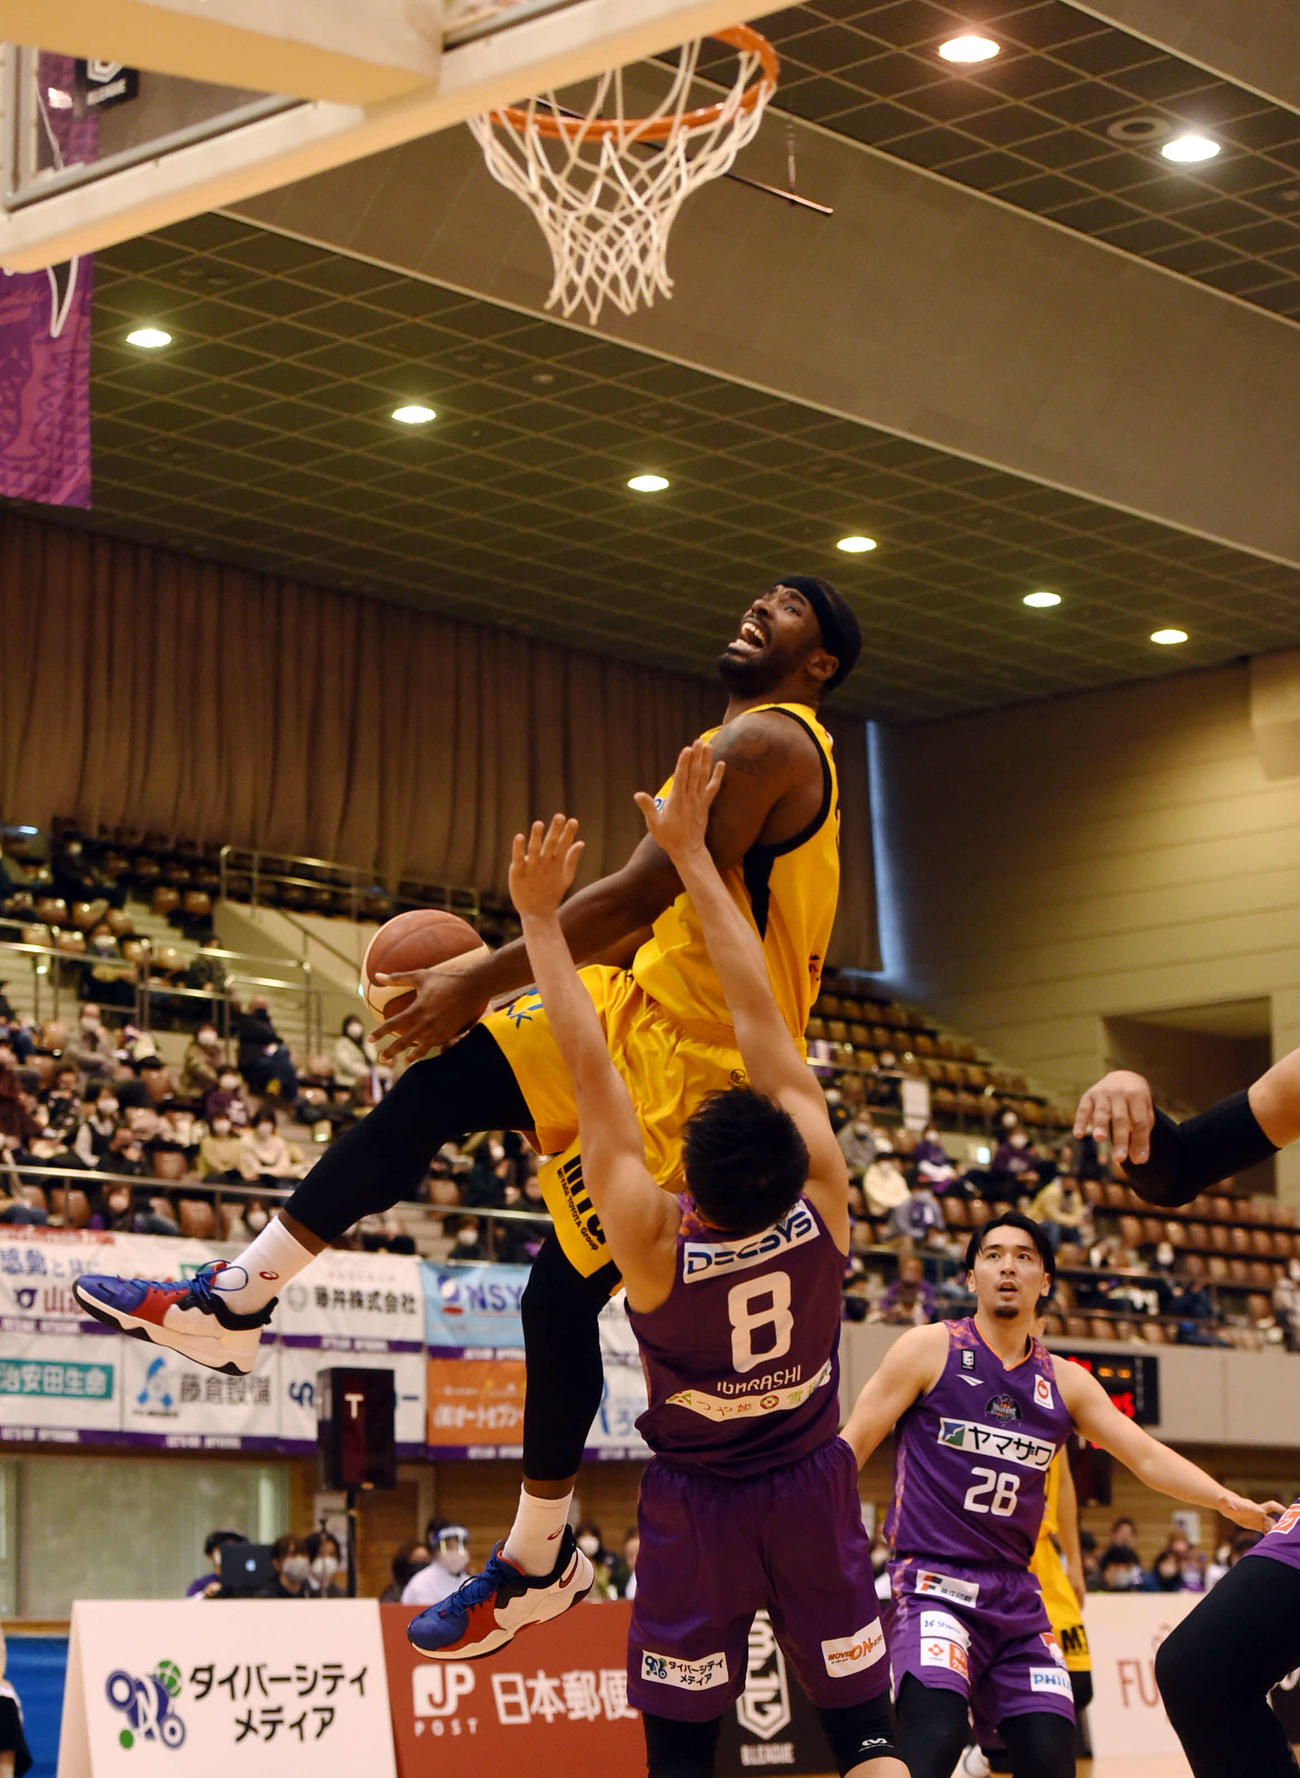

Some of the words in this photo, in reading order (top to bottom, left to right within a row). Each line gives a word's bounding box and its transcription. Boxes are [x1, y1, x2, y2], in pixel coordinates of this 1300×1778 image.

[581, 1227, 599, 1251] Group
[728, 1271, 795, 1374] 8
[968, 1426, 1053, 1466] ヤマザワ
[963, 1466, 1020, 1517] 28
[189, 1664, 368, 1700] ダイバーシティ
[668, 1659, 724, 1675] ダイバーシティ
[680, 1673, 712, 1686] メディア
[1116, 1659, 1162, 1708] FU
[491, 1669, 638, 1725] 日本郵便
[235, 1706, 335, 1743] メディア
[414, 1717, 479, 1737] POST
